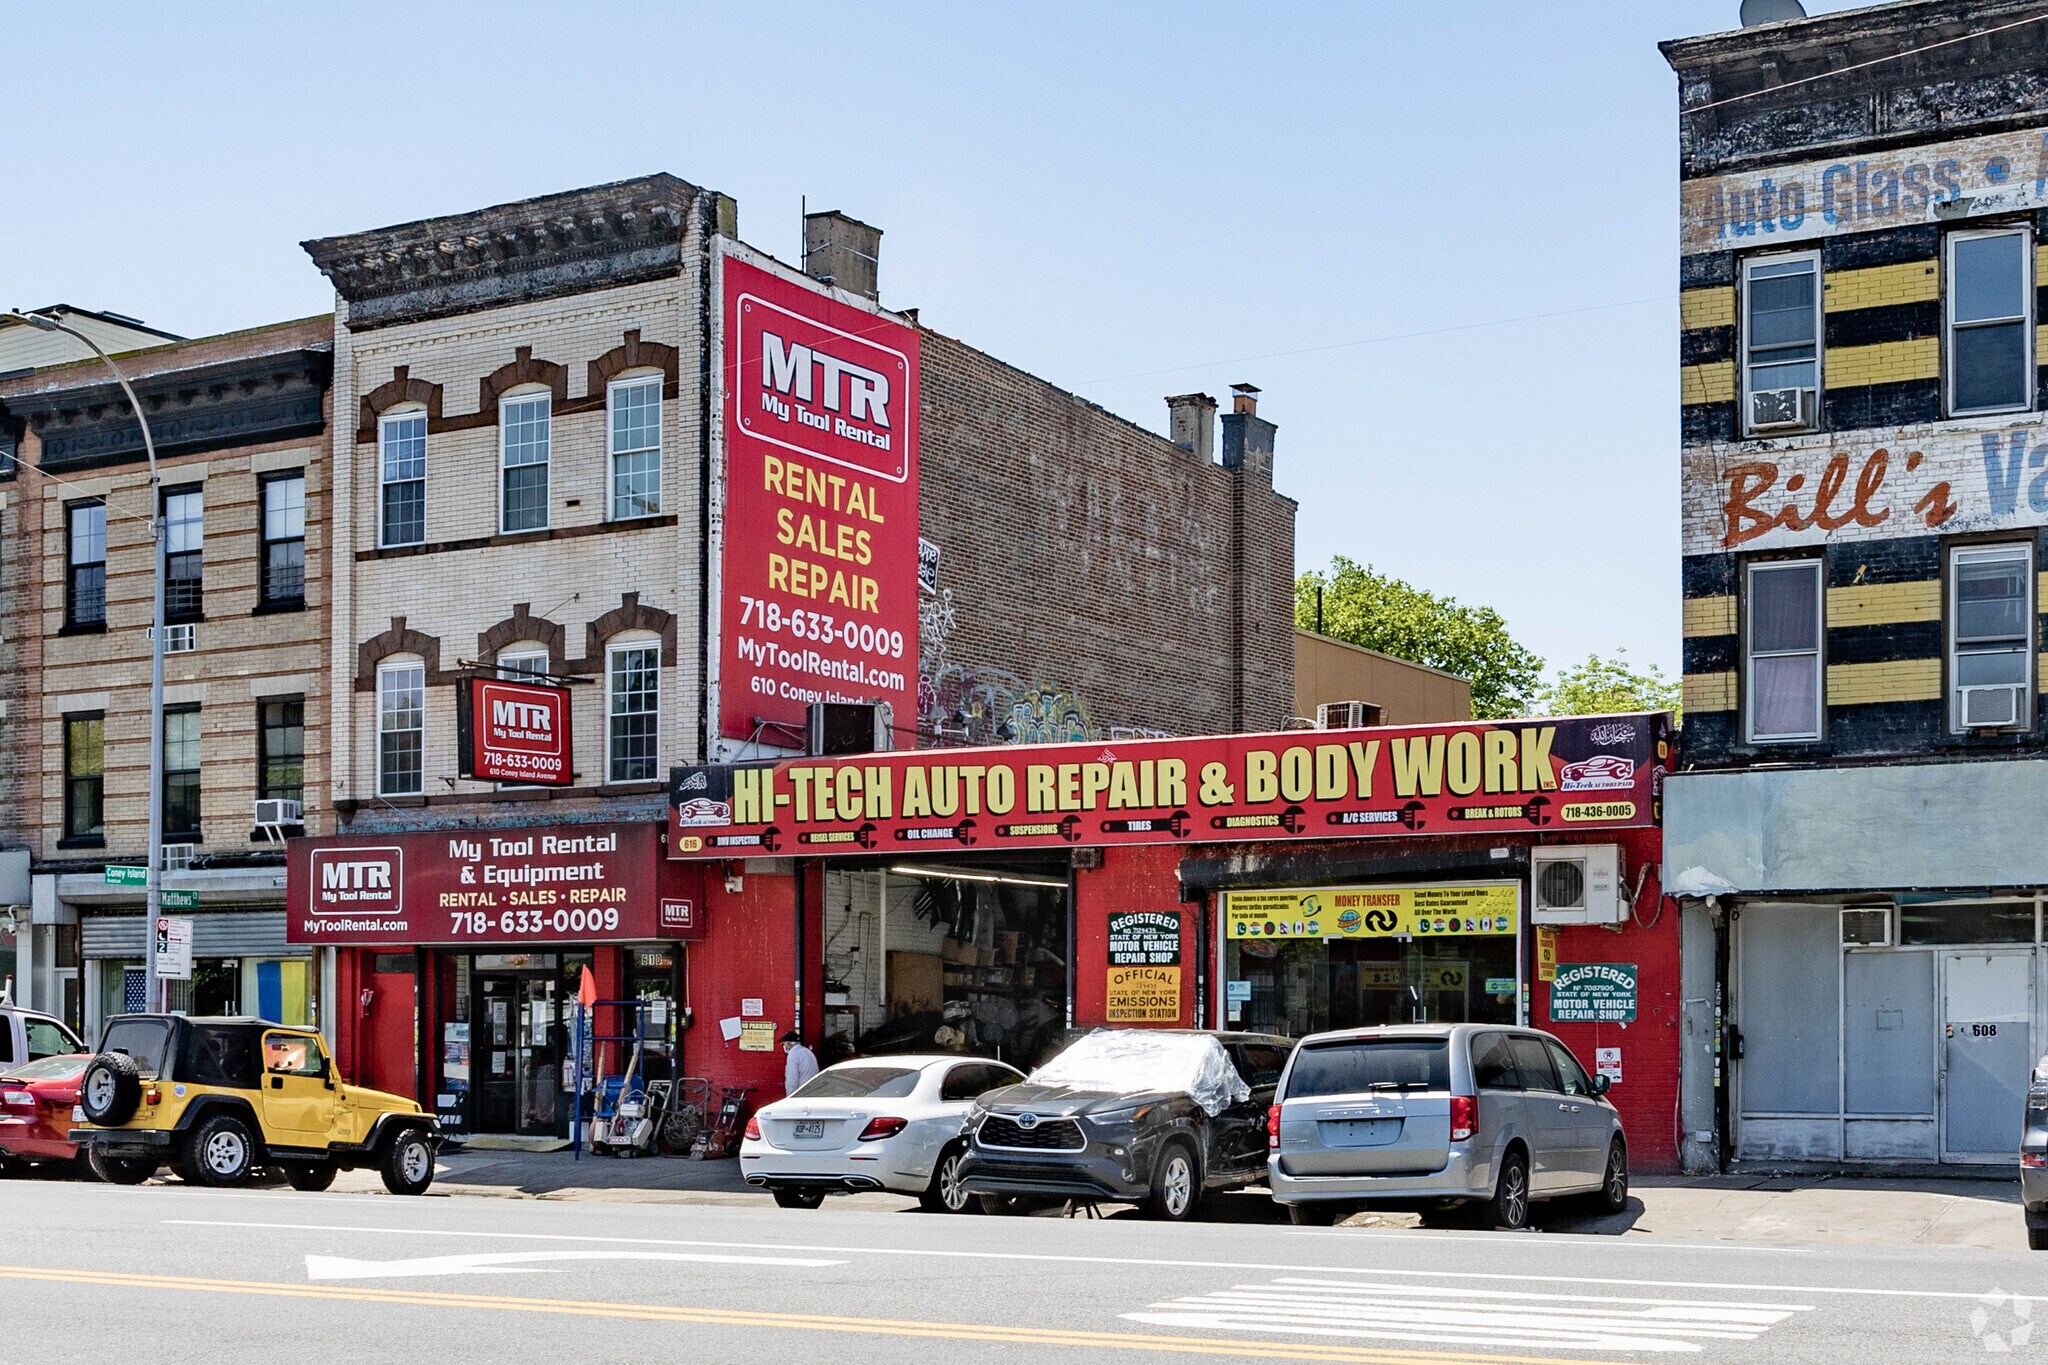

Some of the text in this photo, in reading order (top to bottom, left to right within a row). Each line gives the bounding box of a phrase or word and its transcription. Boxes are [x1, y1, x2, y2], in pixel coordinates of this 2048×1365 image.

[1702, 178, 1805, 240] Auto
[1822, 158, 1962, 226] Glass
[762, 329, 891, 430] MTR
[761, 392, 891, 451] My Tool Rental
[763, 454, 885, 524] RENTAL
[1721, 448, 1957, 549] Bill's
[776, 507, 872, 566] SALES
[768, 553, 880, 614] REPAIR
[739, 595, 904, 659] 718-633-0009
[737, 635, 905, 692] MyToolRental.com
[751, 675, 777, 696] 610
[779, 681, 823, 703] Coney
[492, 699, 552, 731] MTR
[493, 727, 552, 742] My Tool Rental
[483, 752, 562, 772] 718-633-0009
[489, 767, 557, 780] 610 Coney Island Avenue
[733, 765, 892, 824] HI-TECH
[902, 764, 1015, 818] AUTO
[1027, 759, 1187, 812] REPAIR
[1199, 761, 1236, 805] &
[1246, 740, 1381, 803] BODY
[1391, 727, 1557, 796] WORK
[1563, 781, 1593, 789] Hi-Tech
[1342, 810, 1398, 823] A/C SERVICES
[1464, 806, 1523, 819] BREAK & ROTORS
[1565, 804, 1632, 818] 718-436-0005
[1127, 820, 1152, 831] TIRES
[1226, 815, 1279, 828] DIAGNOSTICS
[907, 827, 954, 839] OIL CHANGE
[1009, 823, 1058, 836] SUSPENSIONS
[730, 835, 760, 845] INSPECTION
[828, 832, 855, 842] SERVICES
[449, 832, 617, 862] My Tool Rental
[684, 839, 697, 849] 616
[106, 867, 146, 879] Coney Island
[322, 861, 392, 889] MTR
[460, 862, 605, 888] & Equipment
[161, 891, 192, 906] Matthews
[322, 890, 392, 903] My Tool Rental
[439, 887, 627, 907] RENTAL SALES REPAIR
[1334, 893, 1401, 907] MONEY TRANSFER
[1414, 890, 1426, 898] Send
[1427, 890, 1443, 898] Money
[1461, 889, 1476, 897] Loved
[1414, 899, 1425, 907] Best
[1440, 899, 1468, 907] Guaranteed
[665, 904, 689, 917] MTR
[1442, 907, 1457, 915] World
[303, 918, 409, 934] MyToolRental.com
[450, 907, 619, 934] 718-633-0009
[1110, 912, 1179, 932] REGISTERED
[159, 943, 166, 953] 2
[1109, 940, 1179, 952] MOTOR VEHICLE
[641, 953, 662, 966] 610
[1114, 952, 1173, 964] REPAIR SHOP
[1113, 969, 1174, 985] OFFICIAL
[1552, 965, 1636, 991] REGISTERED
[1109, 996, 1177, 1007] EMISSIONS
[1553, 999, 1636, 1009] MOTOR VEHICLE
[1108, 1008, 1177, 1019] INSPECTION STATION
[1557, 1010, 1627, 1020] REPAIR SHOP
[1972, 1024, 1997, 1037] 608
